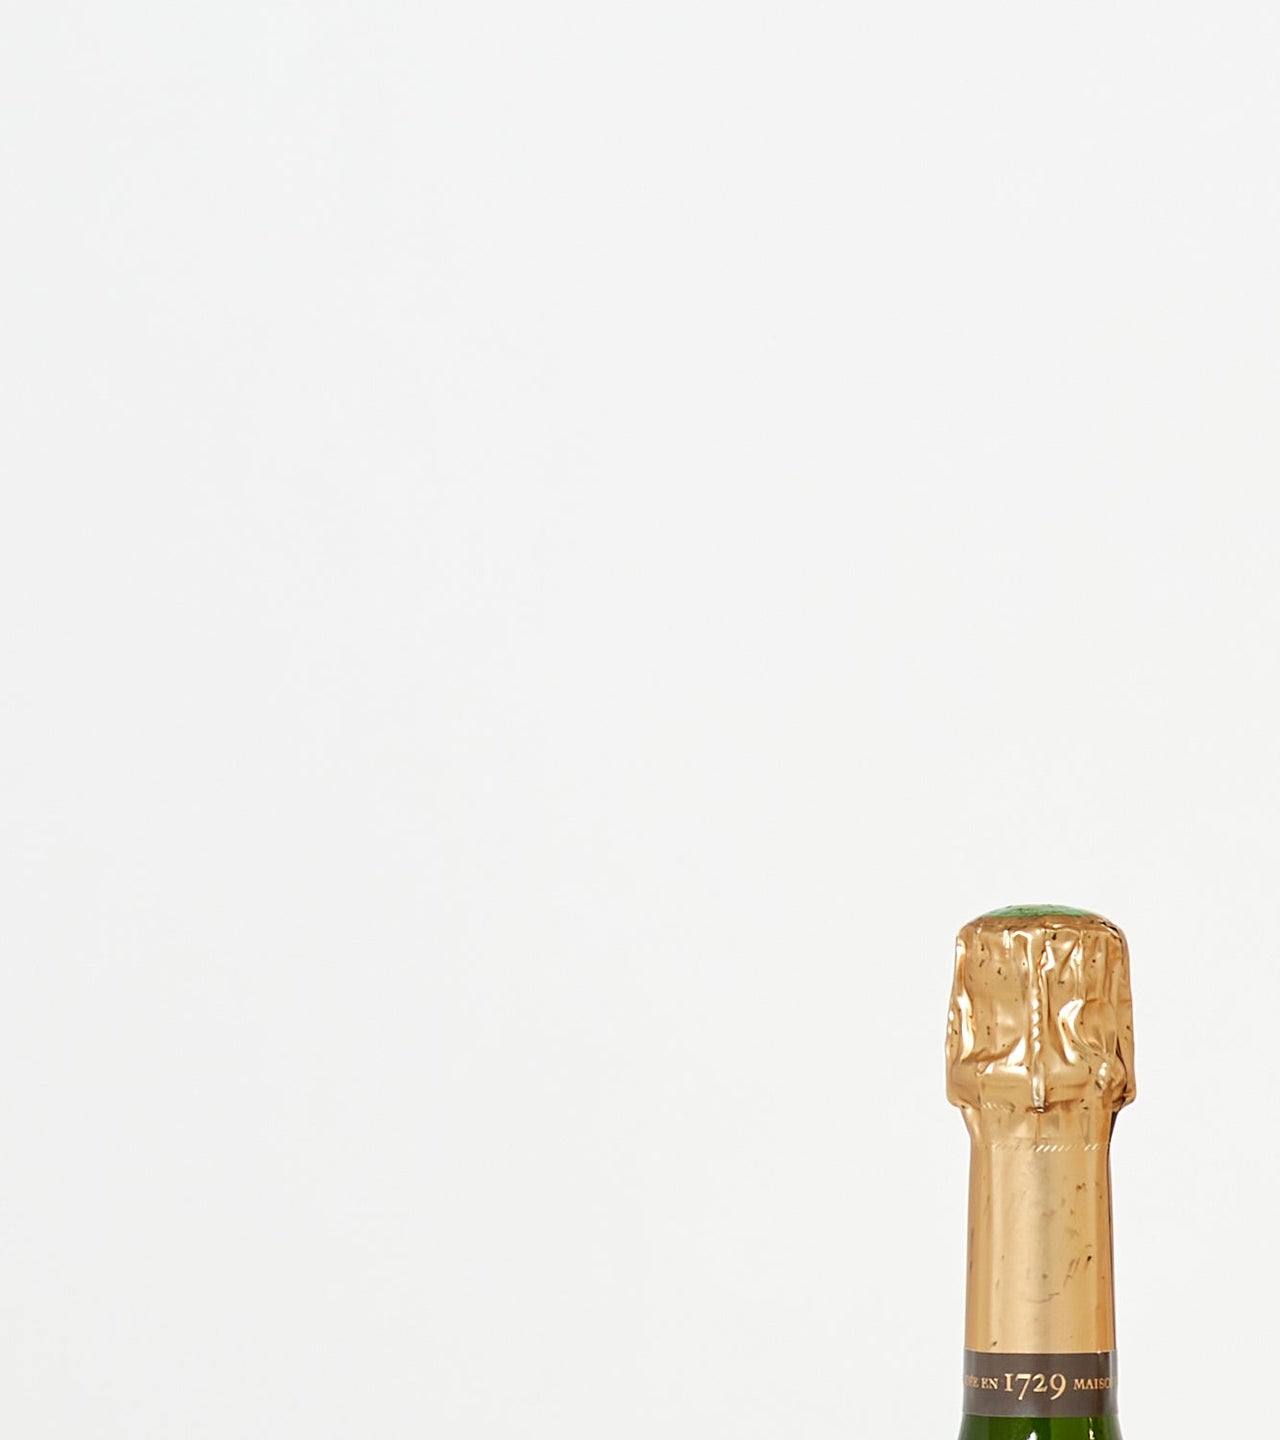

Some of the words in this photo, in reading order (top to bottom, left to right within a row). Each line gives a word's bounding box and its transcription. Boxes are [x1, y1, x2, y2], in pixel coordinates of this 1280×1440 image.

[981, 1377, 999, 1390] EN
[1003, 1373, 1067, 1401] 1729
[1073, 1377, 1114, 1390] MAISO
